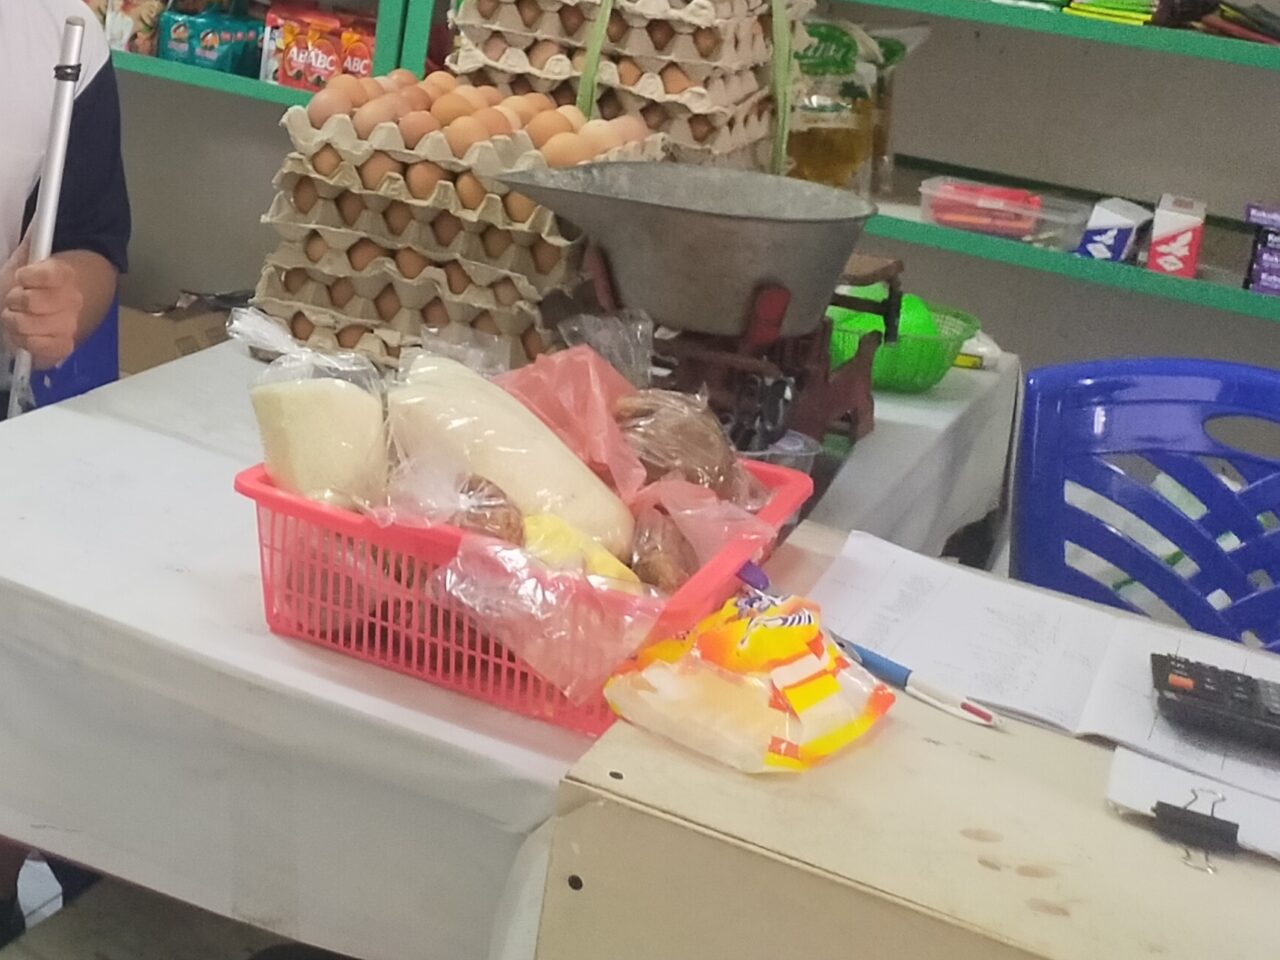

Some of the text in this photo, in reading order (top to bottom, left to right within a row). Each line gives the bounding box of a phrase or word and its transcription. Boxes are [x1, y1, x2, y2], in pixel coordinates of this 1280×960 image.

[288, 45, 309, 64] AB
[306, 47, 337, 71] ABC
[344, 55, 370, 76] ABC
